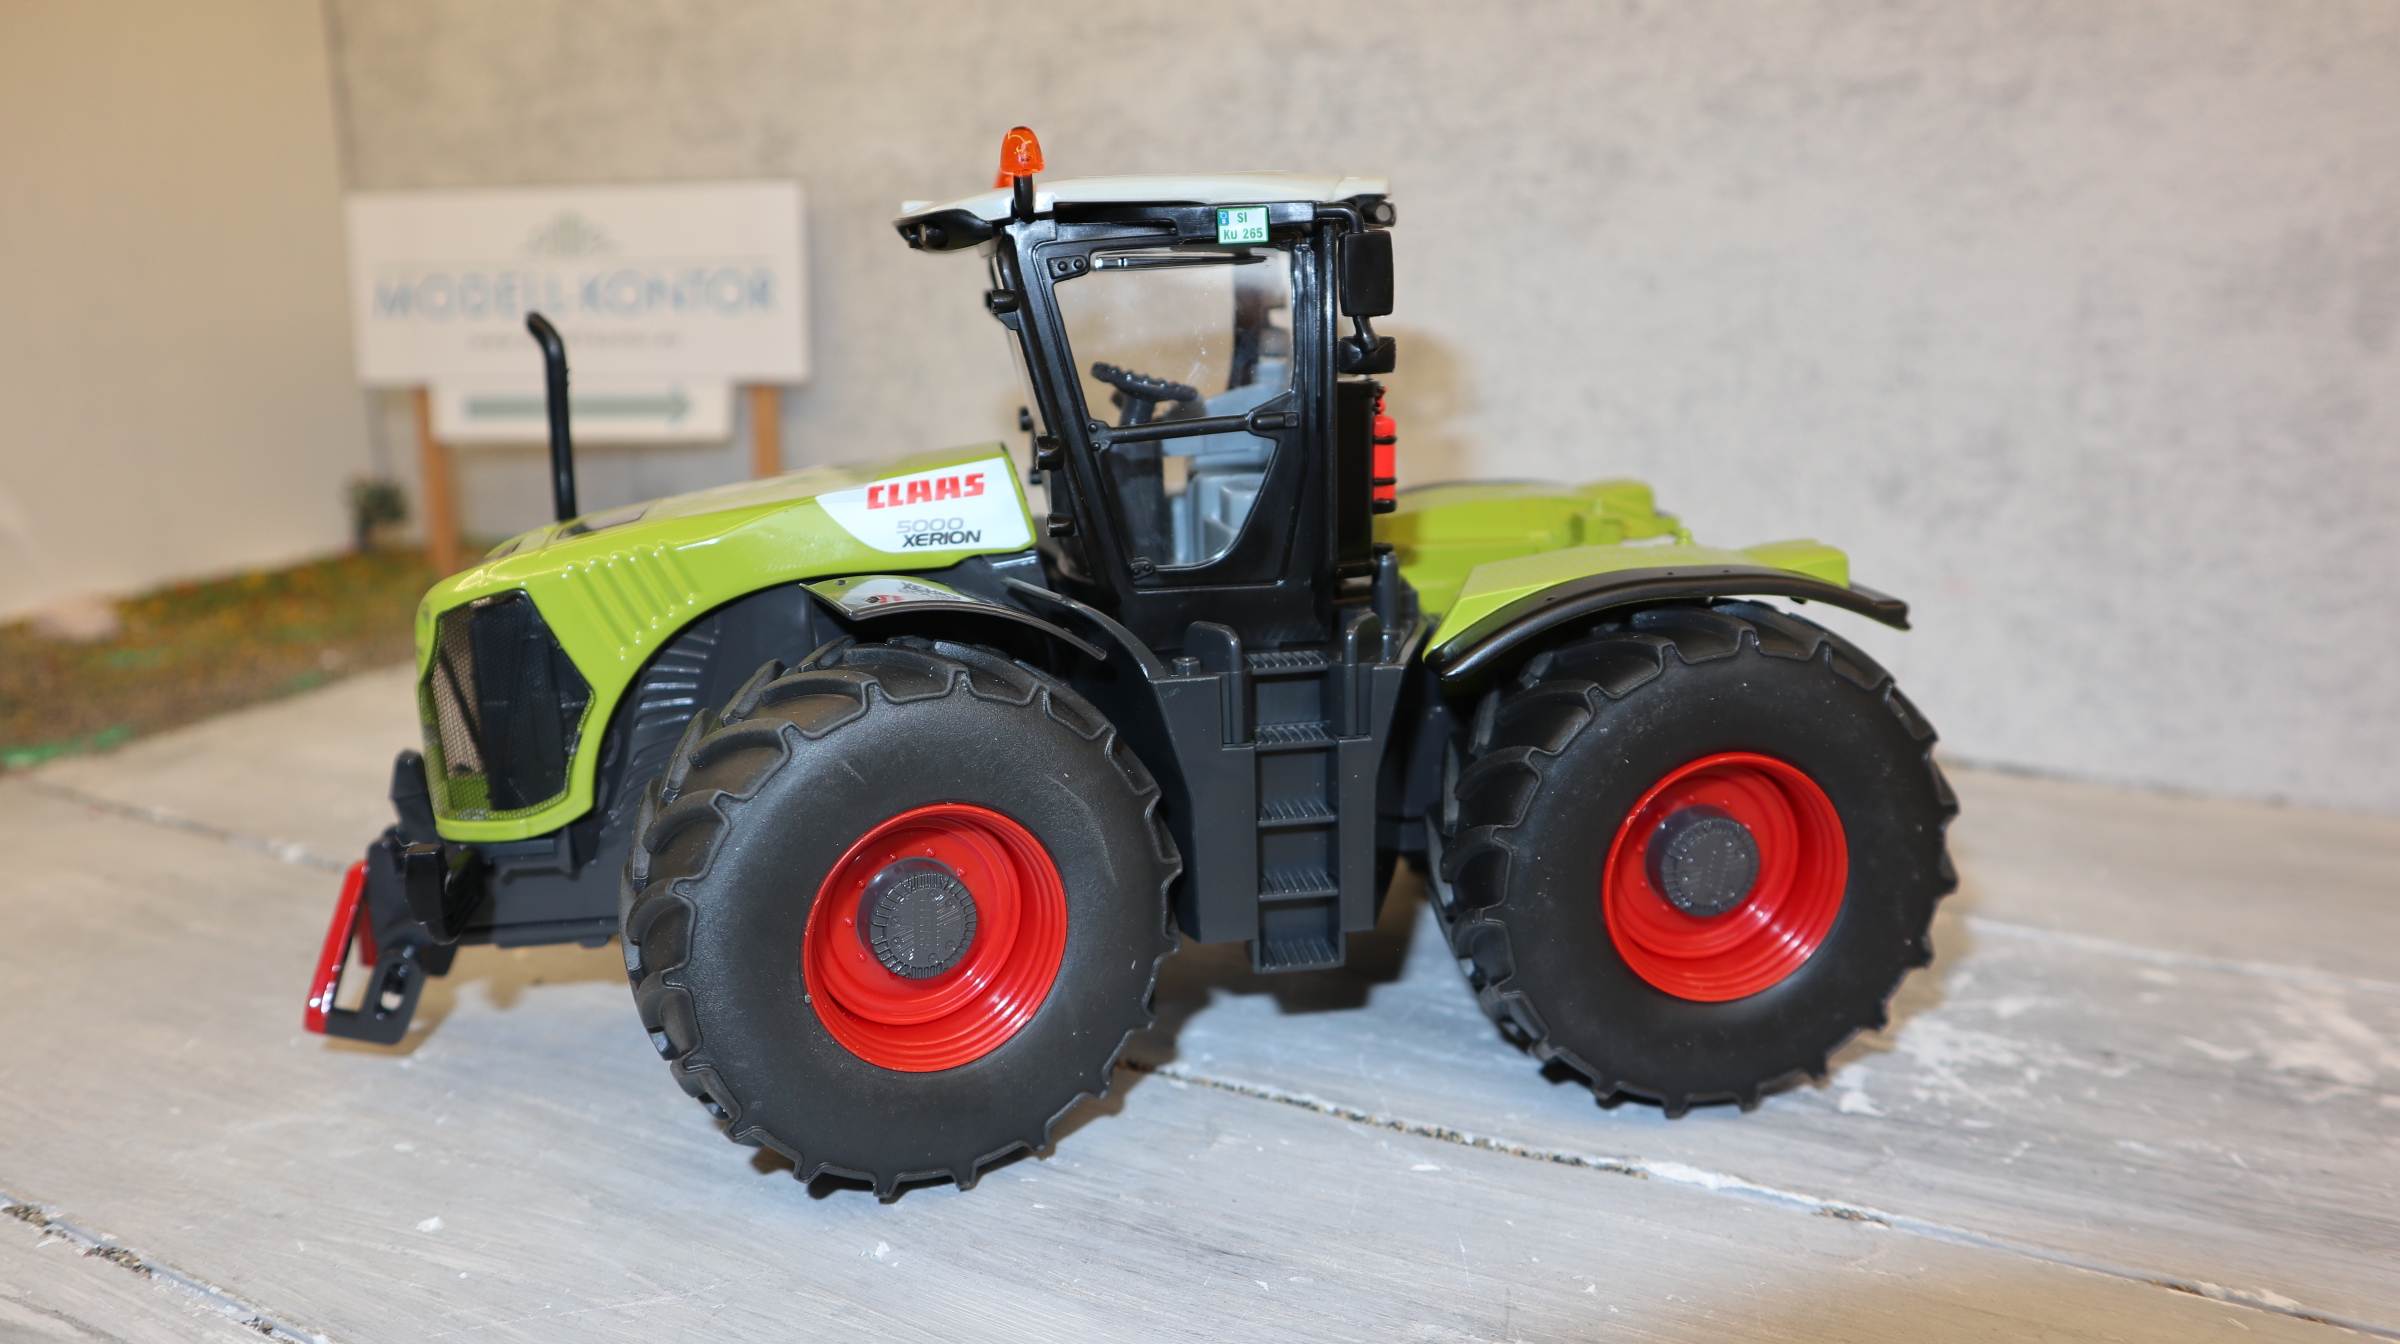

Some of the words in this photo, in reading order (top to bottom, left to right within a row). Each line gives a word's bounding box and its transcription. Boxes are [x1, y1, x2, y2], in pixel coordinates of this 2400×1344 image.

[1237, 212, 1248, 223] SI
[1242, 227, 1264, 239] 265
[867, 472, 985, 510] CLAAS
[896, 517, 964, 533] 5000
[902, 530, 981, 547] XERION
